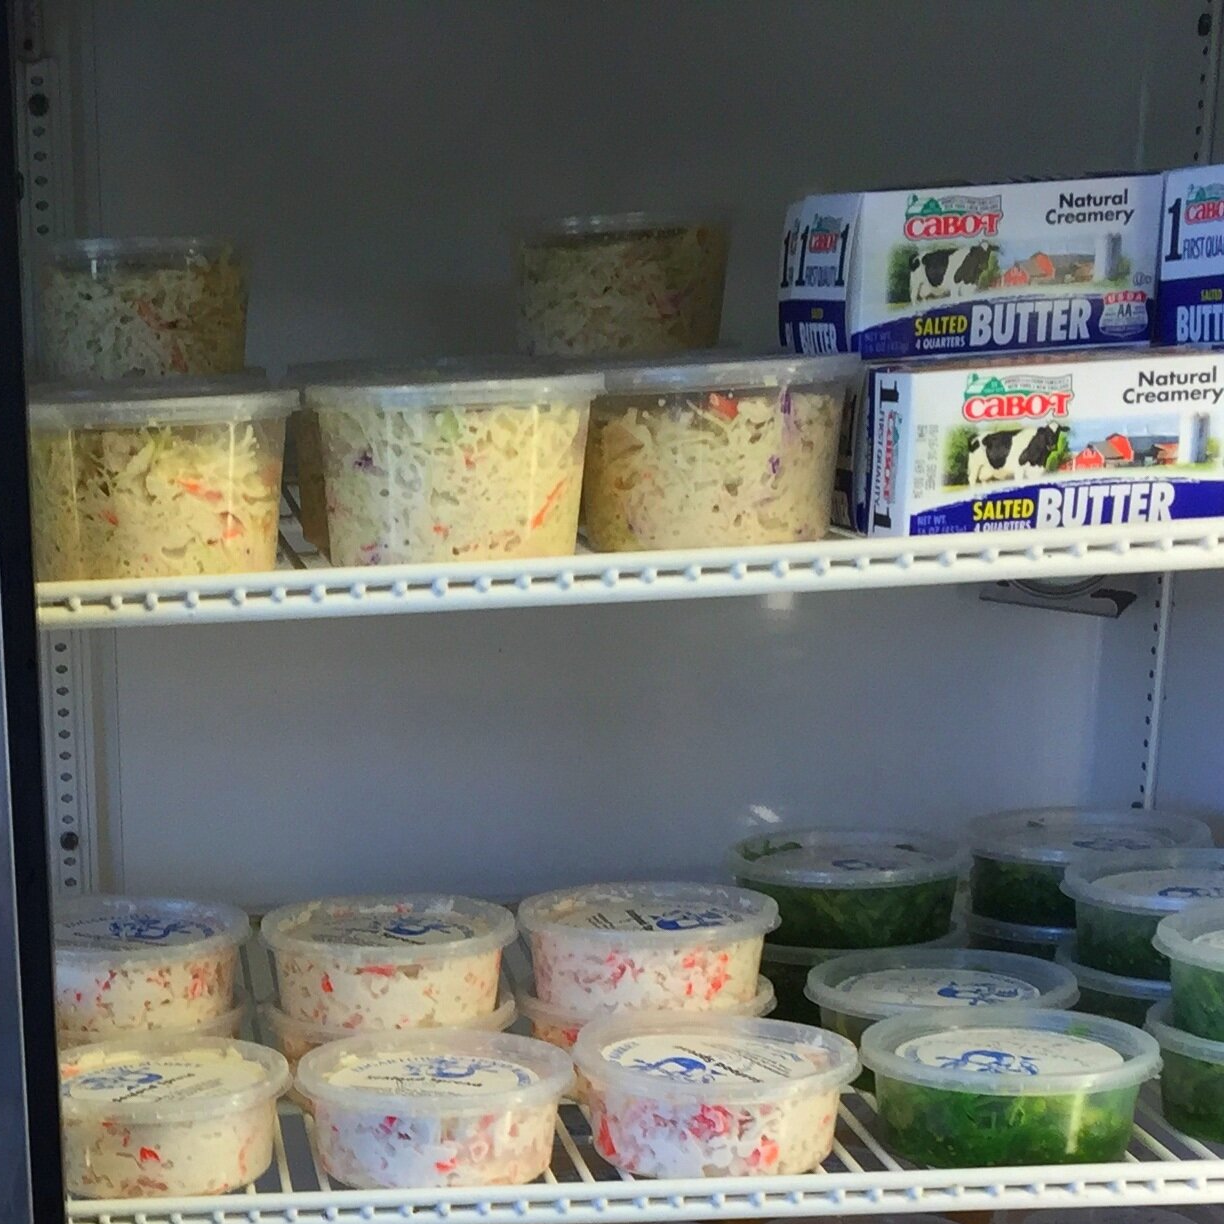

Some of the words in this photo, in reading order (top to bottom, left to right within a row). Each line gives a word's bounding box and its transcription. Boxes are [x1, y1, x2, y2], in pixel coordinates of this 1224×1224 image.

[1059, 188, 1129, 209] Natural
[905, 213, 1002, 241] CABOT
[1045, 208, 1135, 226] Creamery
[1117, 303, 1133, 318] AA
[914, 314, 969, 337] SALTED
[969, 299, 1092, 347] BUTTER
[915, 338, 921, 349] 4
[923, 336, 966, 350] QUARTERS
[1138, 365, 1217, 387] Natural
[963, 393, 1070, 420] CABOT
[1122, 387, 1224, 406] Creamery
[972, 499, 1035, 521] SALTED
[1036, 482, 1176, 530] BUTTER
